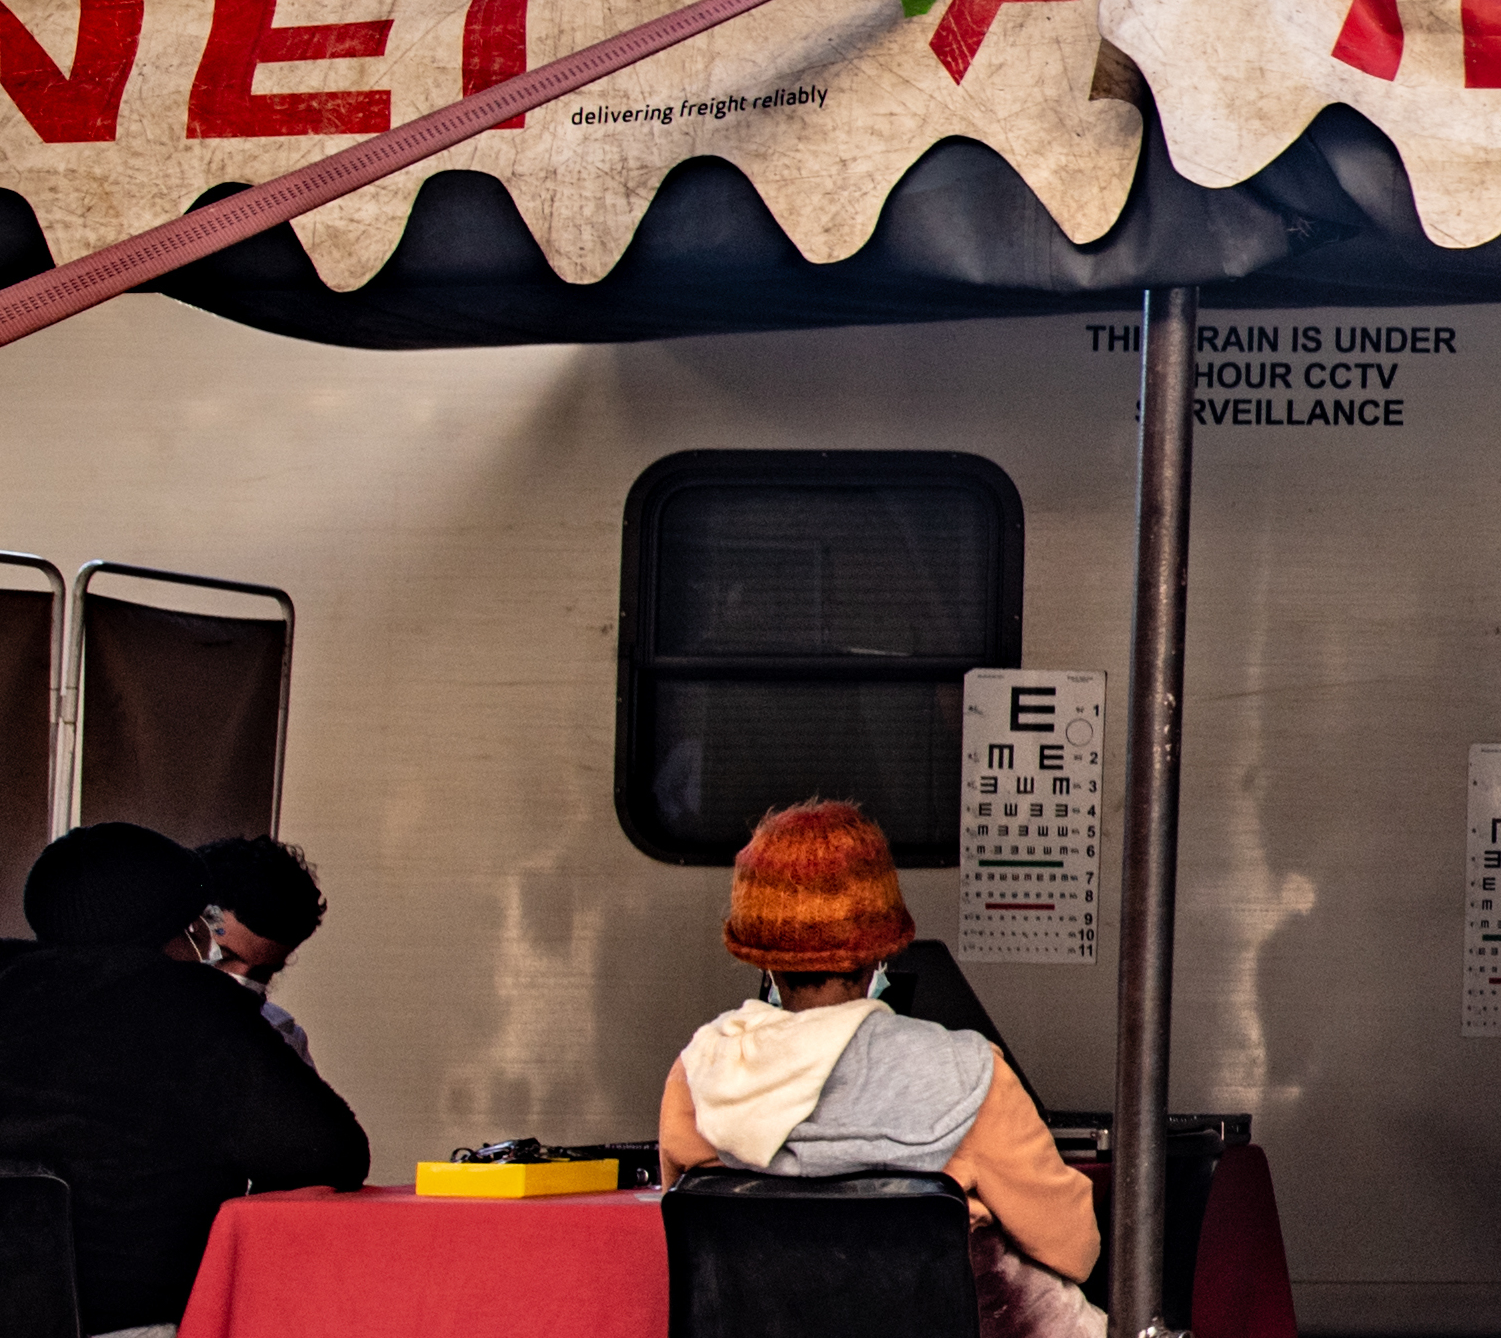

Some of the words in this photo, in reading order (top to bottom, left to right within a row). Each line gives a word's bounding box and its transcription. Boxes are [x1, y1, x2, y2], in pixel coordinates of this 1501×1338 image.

[571, 105, 674, 125] delivering
[680, 95, 747, 120] freight
[752, 85, 828, 109] reliably
[1086, 325, 1141, 352] THI
[1197, 326, 1279, 353] RAIN
[1291, 326, 1322, 353] IS
[1335, 326, 1457, 353] UNDER
[1304, 362, 1398, 389] CCTV
[1135, 400, 1404, 426] RVEILLANCE
[1010, 687, 1056, 731] E
